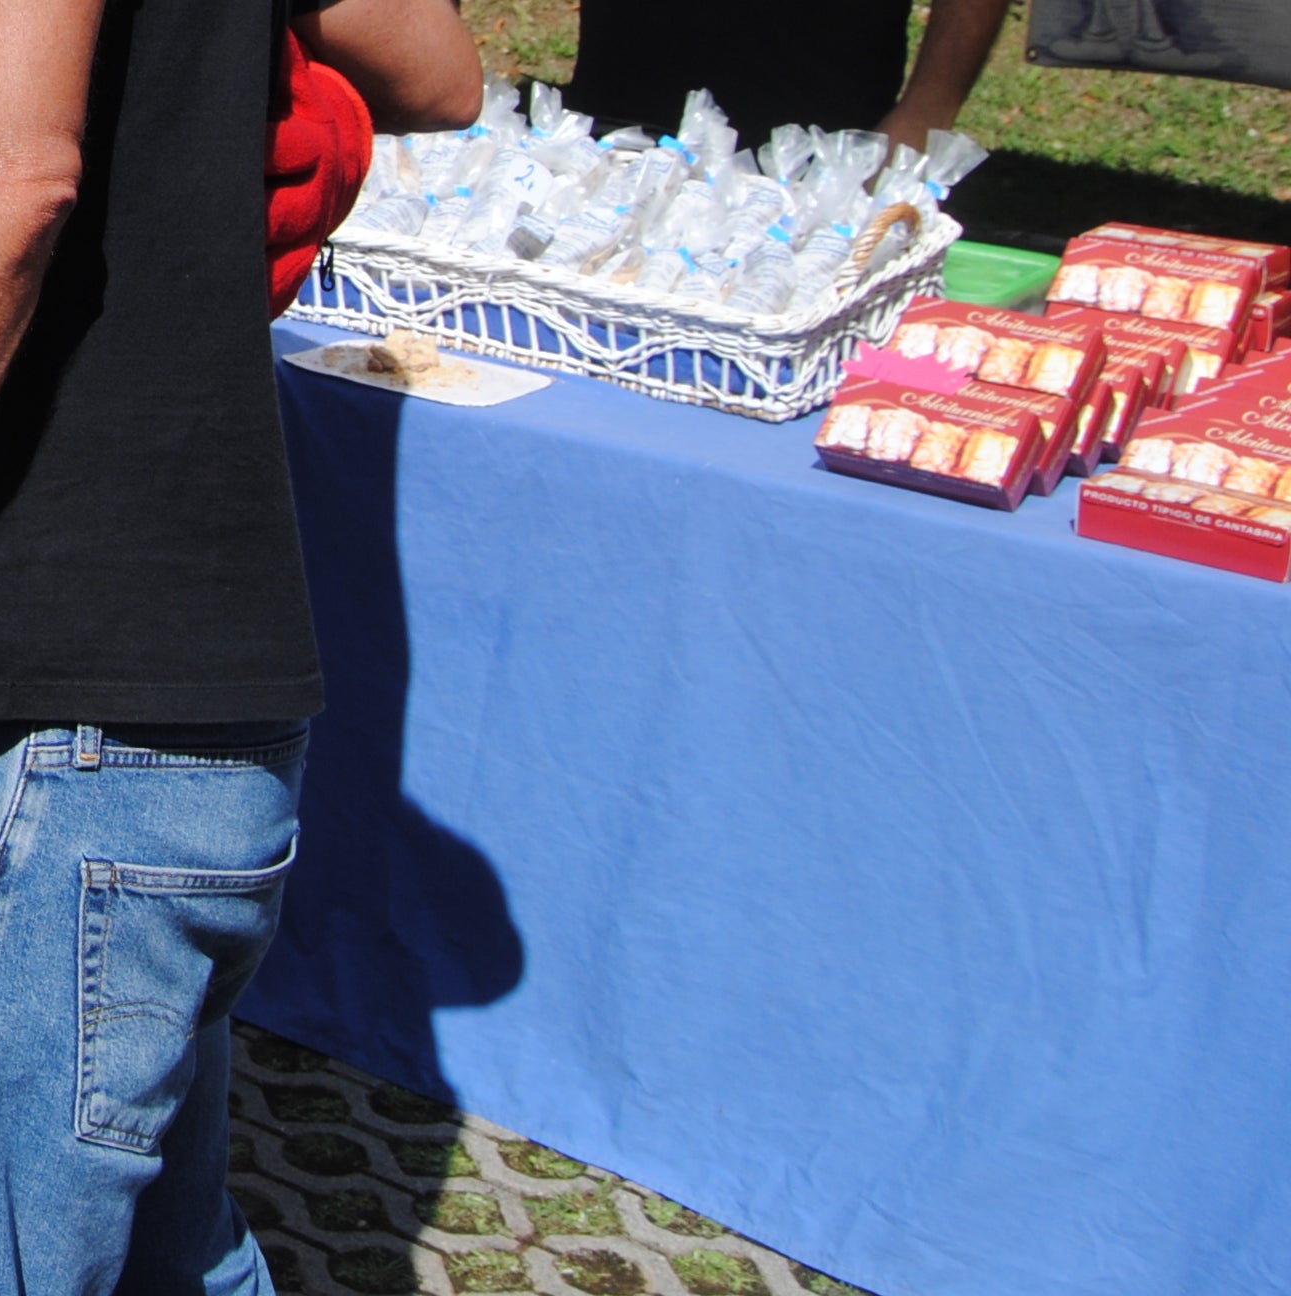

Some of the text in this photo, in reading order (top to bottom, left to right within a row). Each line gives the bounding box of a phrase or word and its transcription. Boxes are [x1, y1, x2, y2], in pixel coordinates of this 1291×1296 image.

[1082, 489, 1149, 511] PRODUCTO
[1194, 514, 1212, 525] DE
[1214, 518, 1284, 542] CANTABRIA
